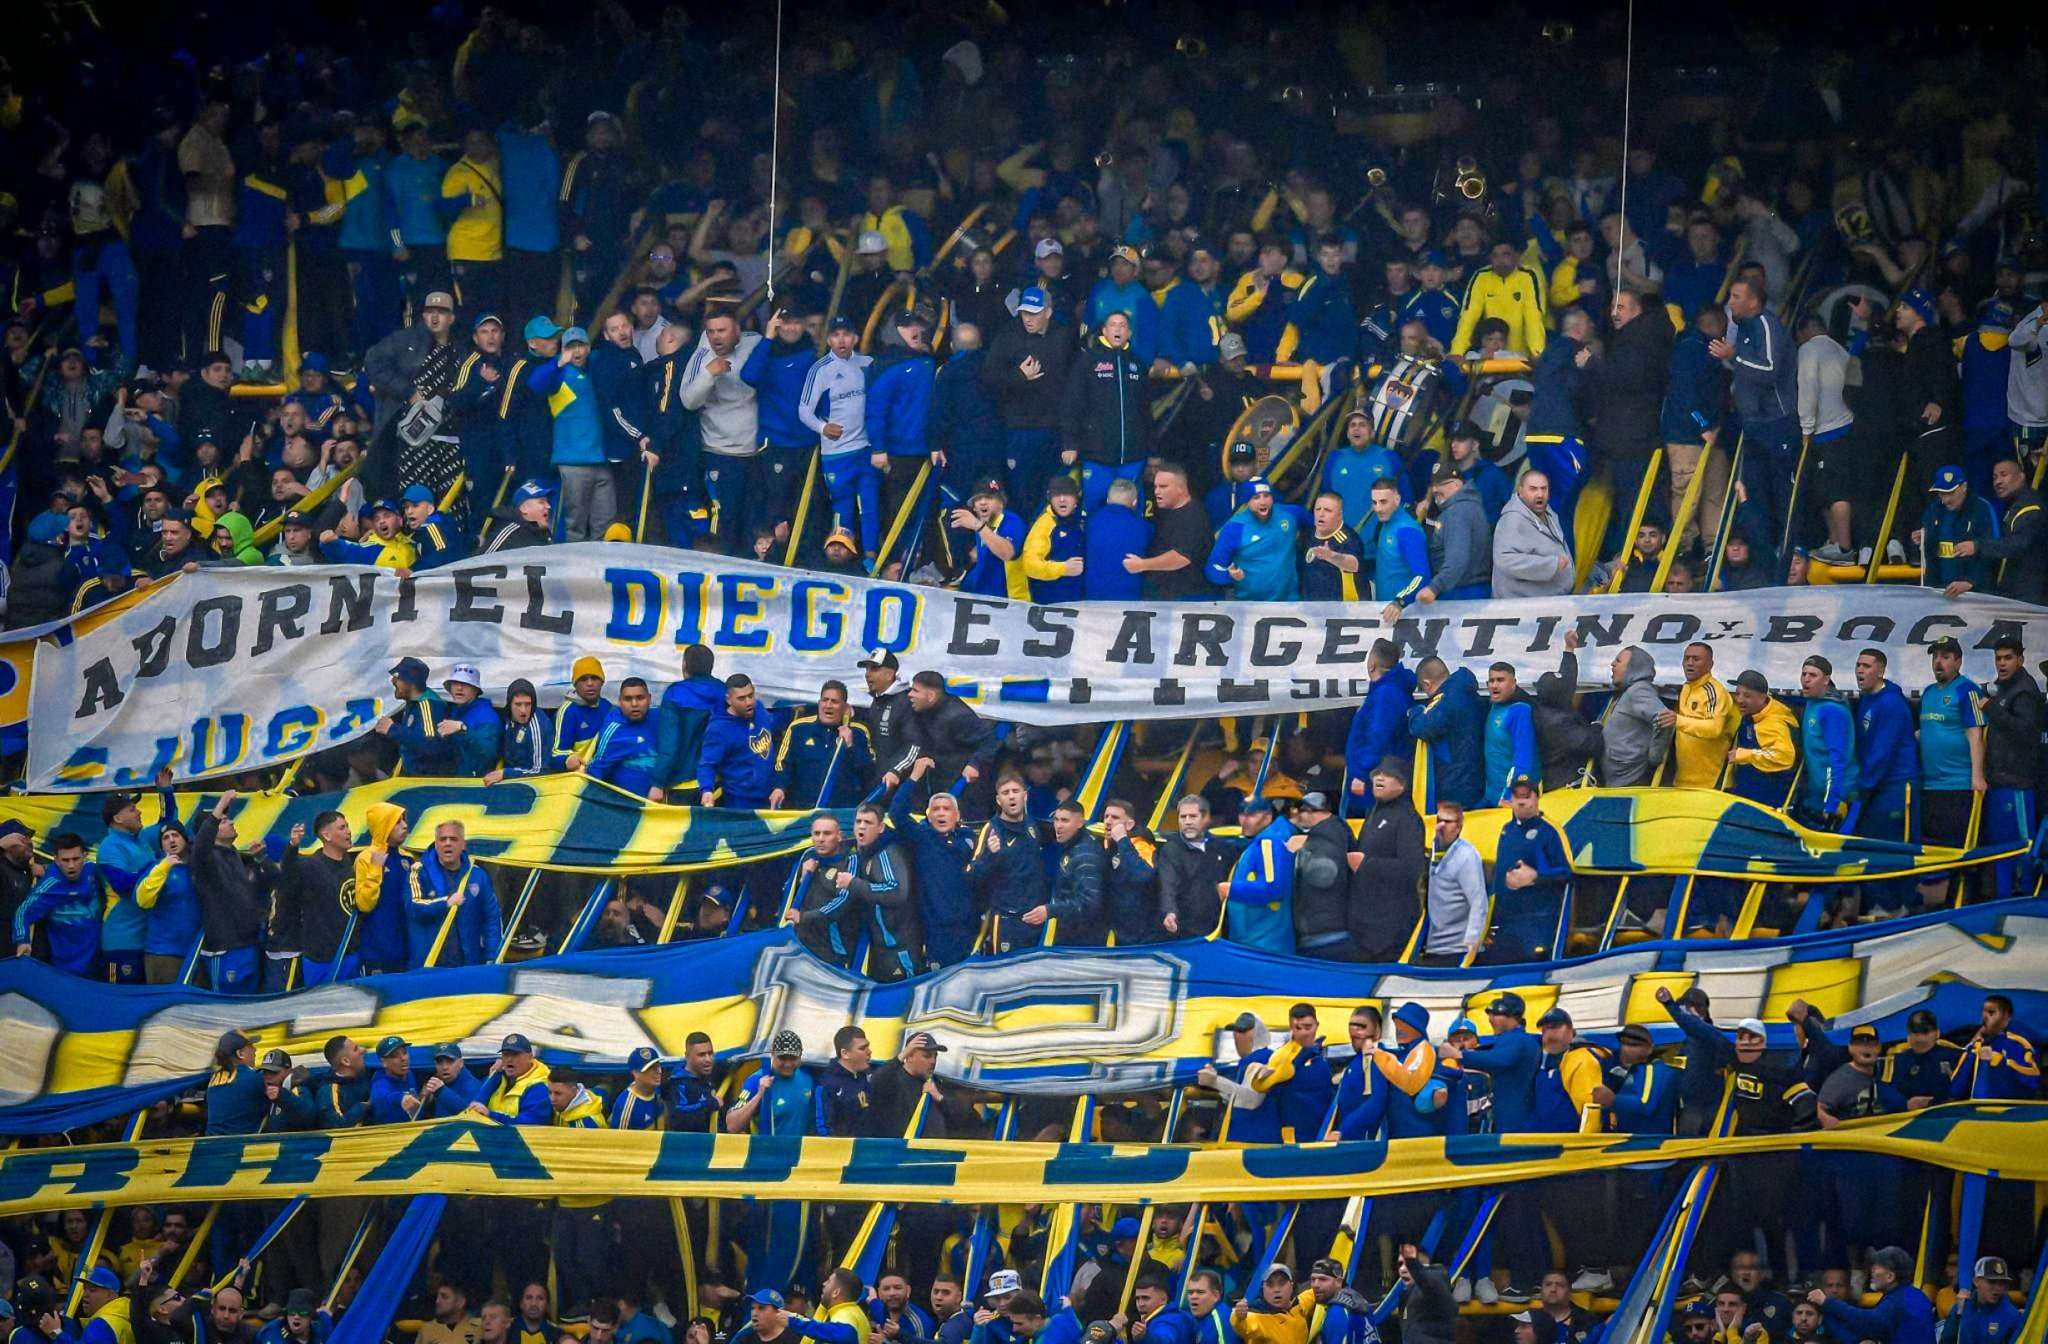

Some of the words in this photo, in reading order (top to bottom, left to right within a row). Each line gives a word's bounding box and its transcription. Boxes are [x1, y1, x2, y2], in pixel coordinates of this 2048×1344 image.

[604, 567, 924, 655] DIEGO
[947, 597, 1079, 657] ES
[1106, 610, 1703, 668] ARGENTINO
[1760, 613, 2029, 650] BOCA
